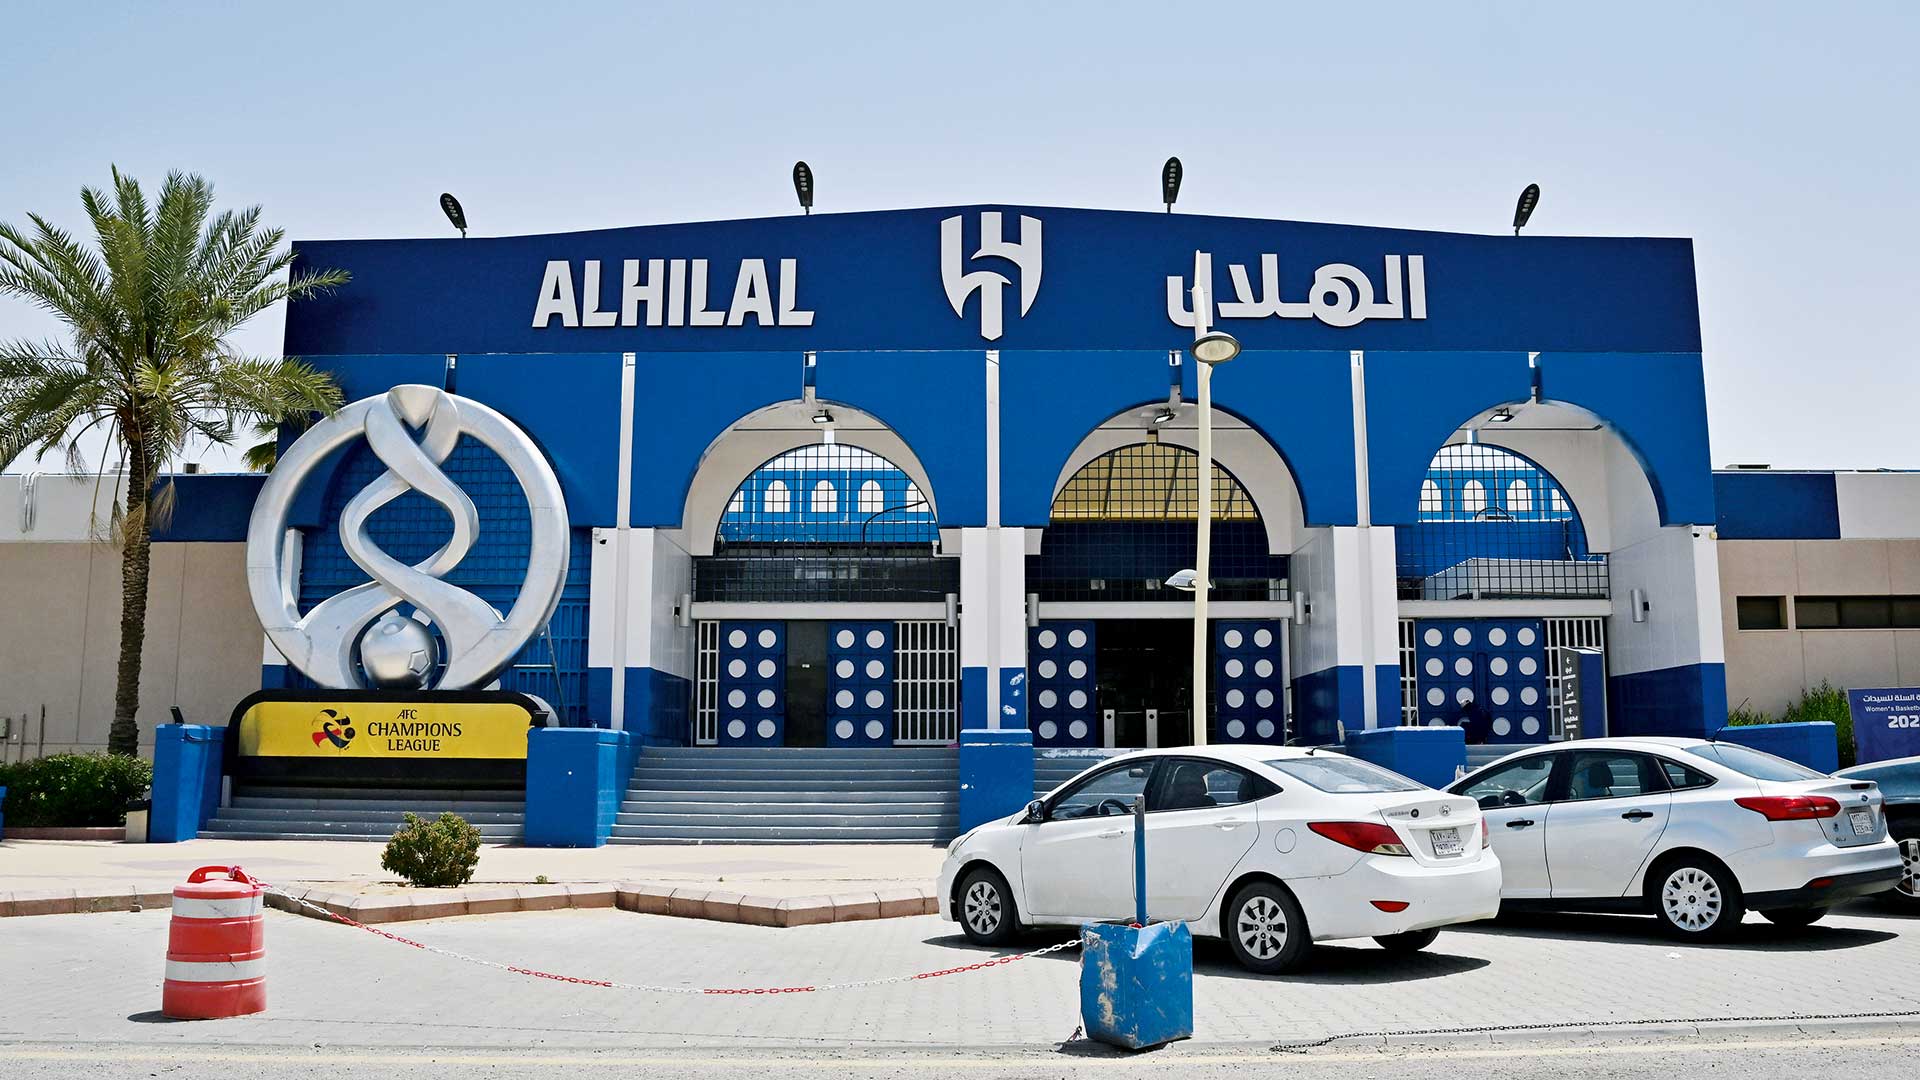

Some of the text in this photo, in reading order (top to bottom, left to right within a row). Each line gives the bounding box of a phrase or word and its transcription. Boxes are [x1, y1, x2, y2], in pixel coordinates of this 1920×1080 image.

[531, 258, 815, 328] ALHILAL
[1166, 252, 1427, 328] الهلال
[397, 709, 418, 720] AFC
[1888, 715, 1920, 728] 202
[367, 722, 462, 737] CHAMPIONS
[388, 739, 441, 751] LEAGUE
